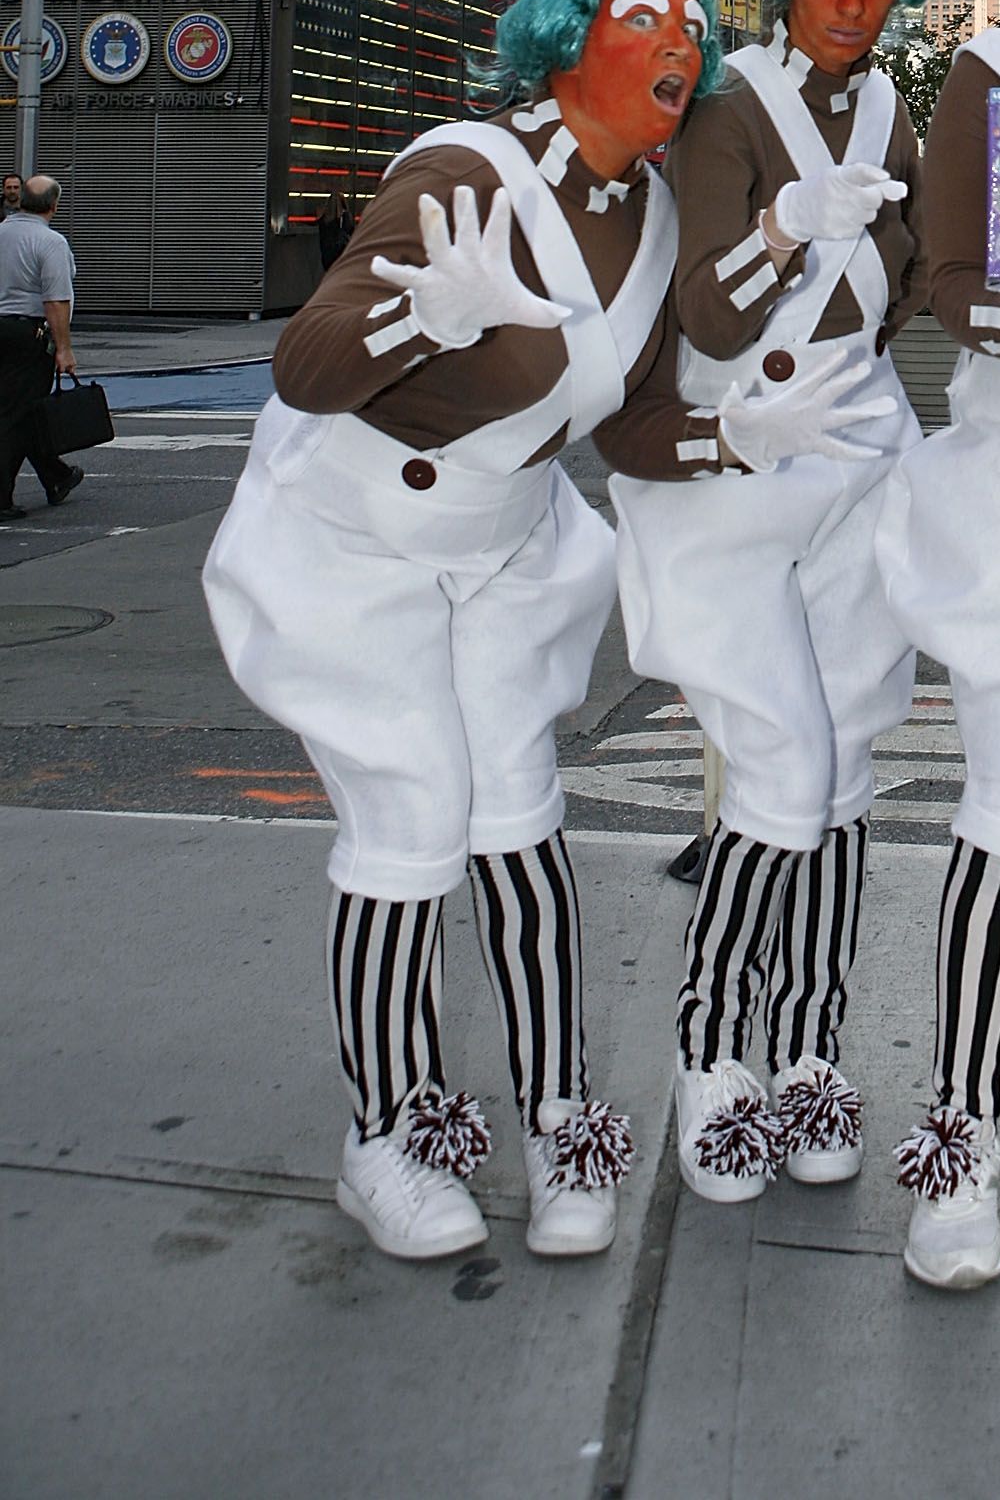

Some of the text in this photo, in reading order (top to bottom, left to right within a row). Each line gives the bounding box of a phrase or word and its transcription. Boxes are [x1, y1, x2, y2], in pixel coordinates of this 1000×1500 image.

[216, 27, 226, 44] NAVY
[52, 91, 234, 108] AIR FORCE MARINES
